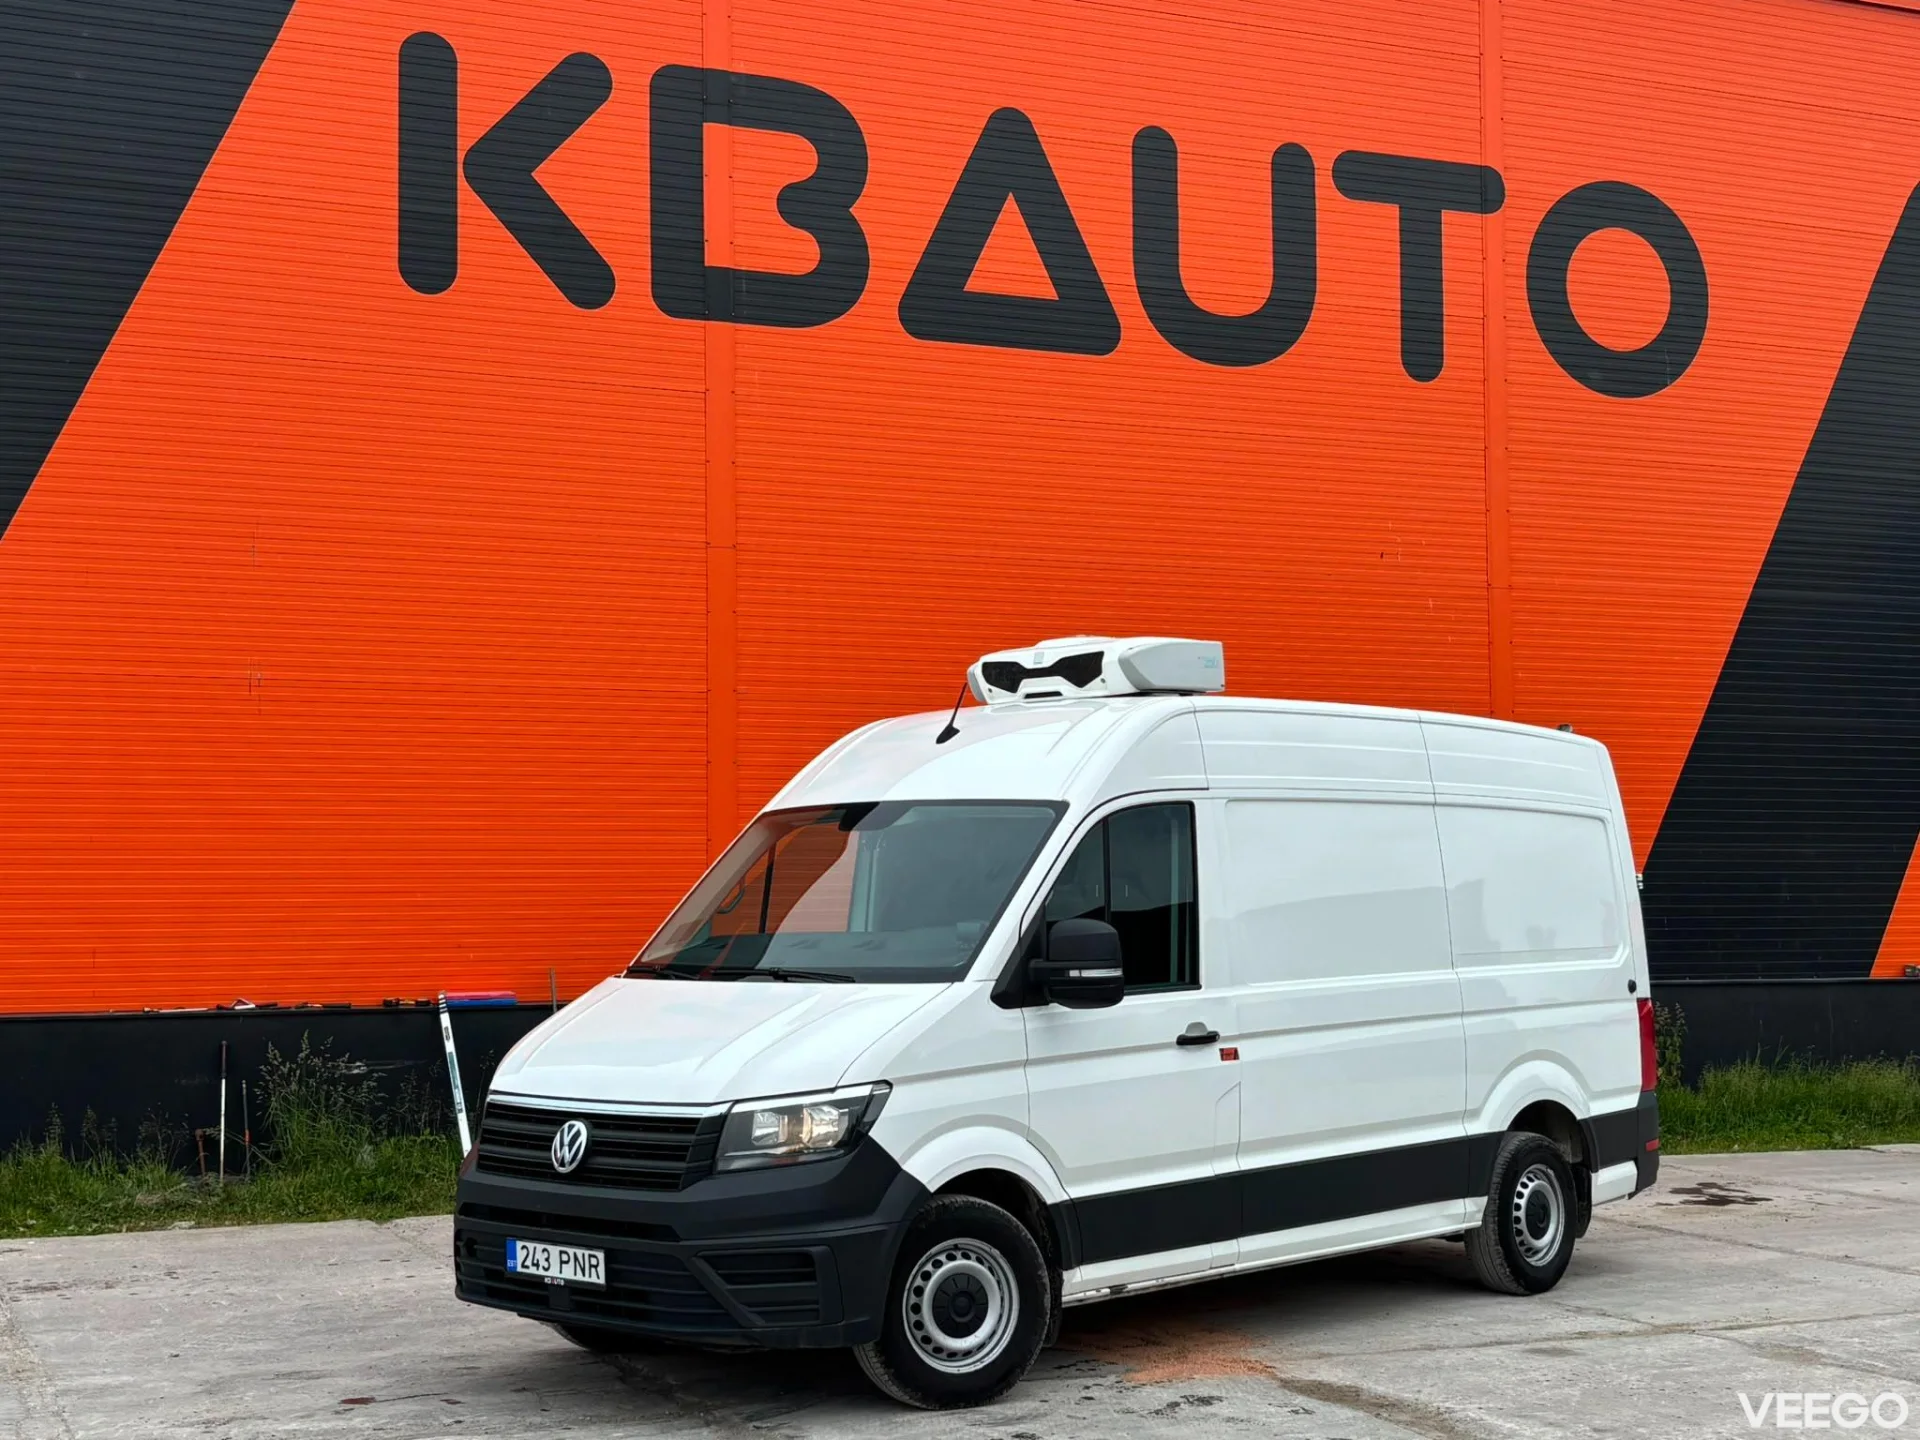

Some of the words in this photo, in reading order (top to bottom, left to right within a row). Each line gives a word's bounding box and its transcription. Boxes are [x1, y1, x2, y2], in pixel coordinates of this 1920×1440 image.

[397, 31, 1709, 398] KBAUTO
[520, 1245, 551, 1272] 243
[559, 1250, 600, 1279] PNR
